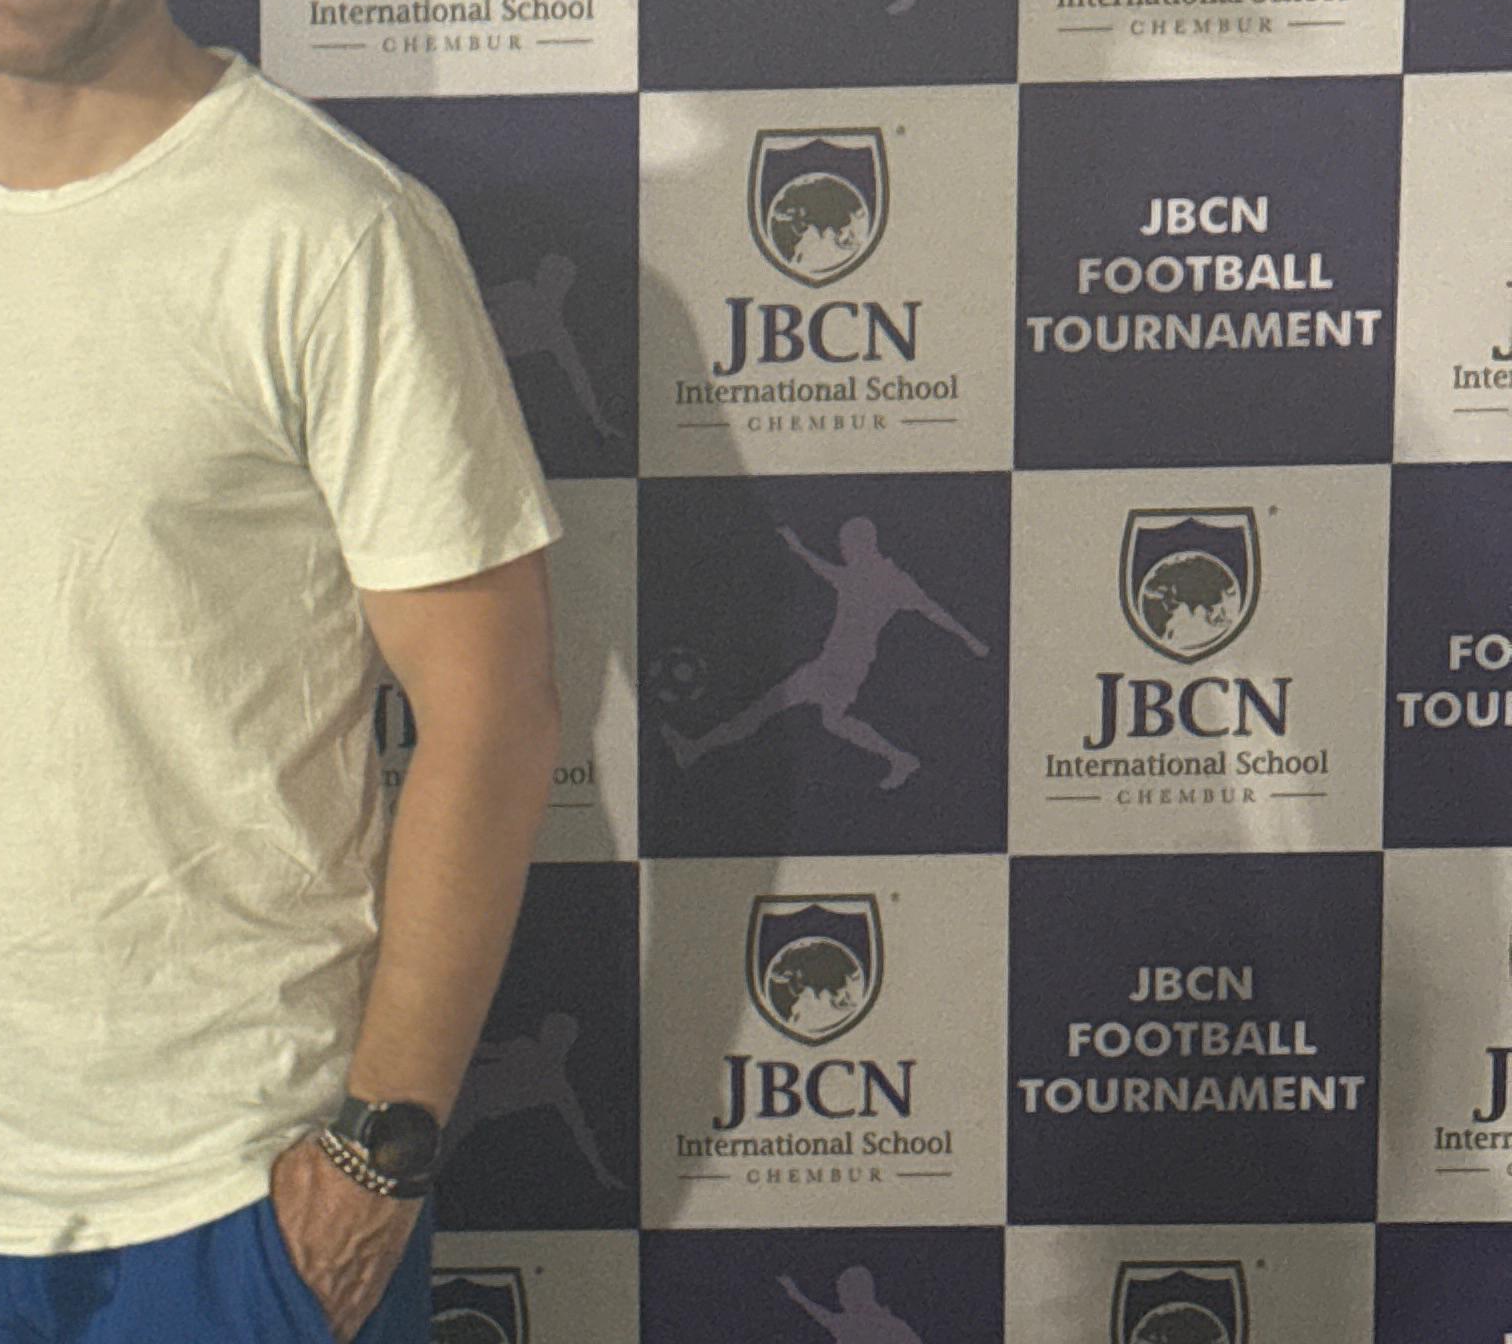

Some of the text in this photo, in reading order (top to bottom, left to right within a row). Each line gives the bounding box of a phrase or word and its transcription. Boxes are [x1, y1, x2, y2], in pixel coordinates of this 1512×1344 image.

[1141, 197, 1267, 235] JBCN
[1080, 253, 1333, 293] FOOTBALL
[713, 297, 922, 375] JBCN
[1027, 310, 1382, 352] TOURNAMENT
[676, 374, 958, 405] International School
[1083, 673, 1292, 749] JBCN
[1046, 749, 1328, 778] International School
[1130, 966, 1252, 1001] JBCN
[1069, 1021, 1317, 1057] FOOTBALL
[713, 1055, 916, 1129] JBCN
[1018, 1076, 1365, 1113] TOURNAMENT
[677, 1129, 952, 1157] International School
